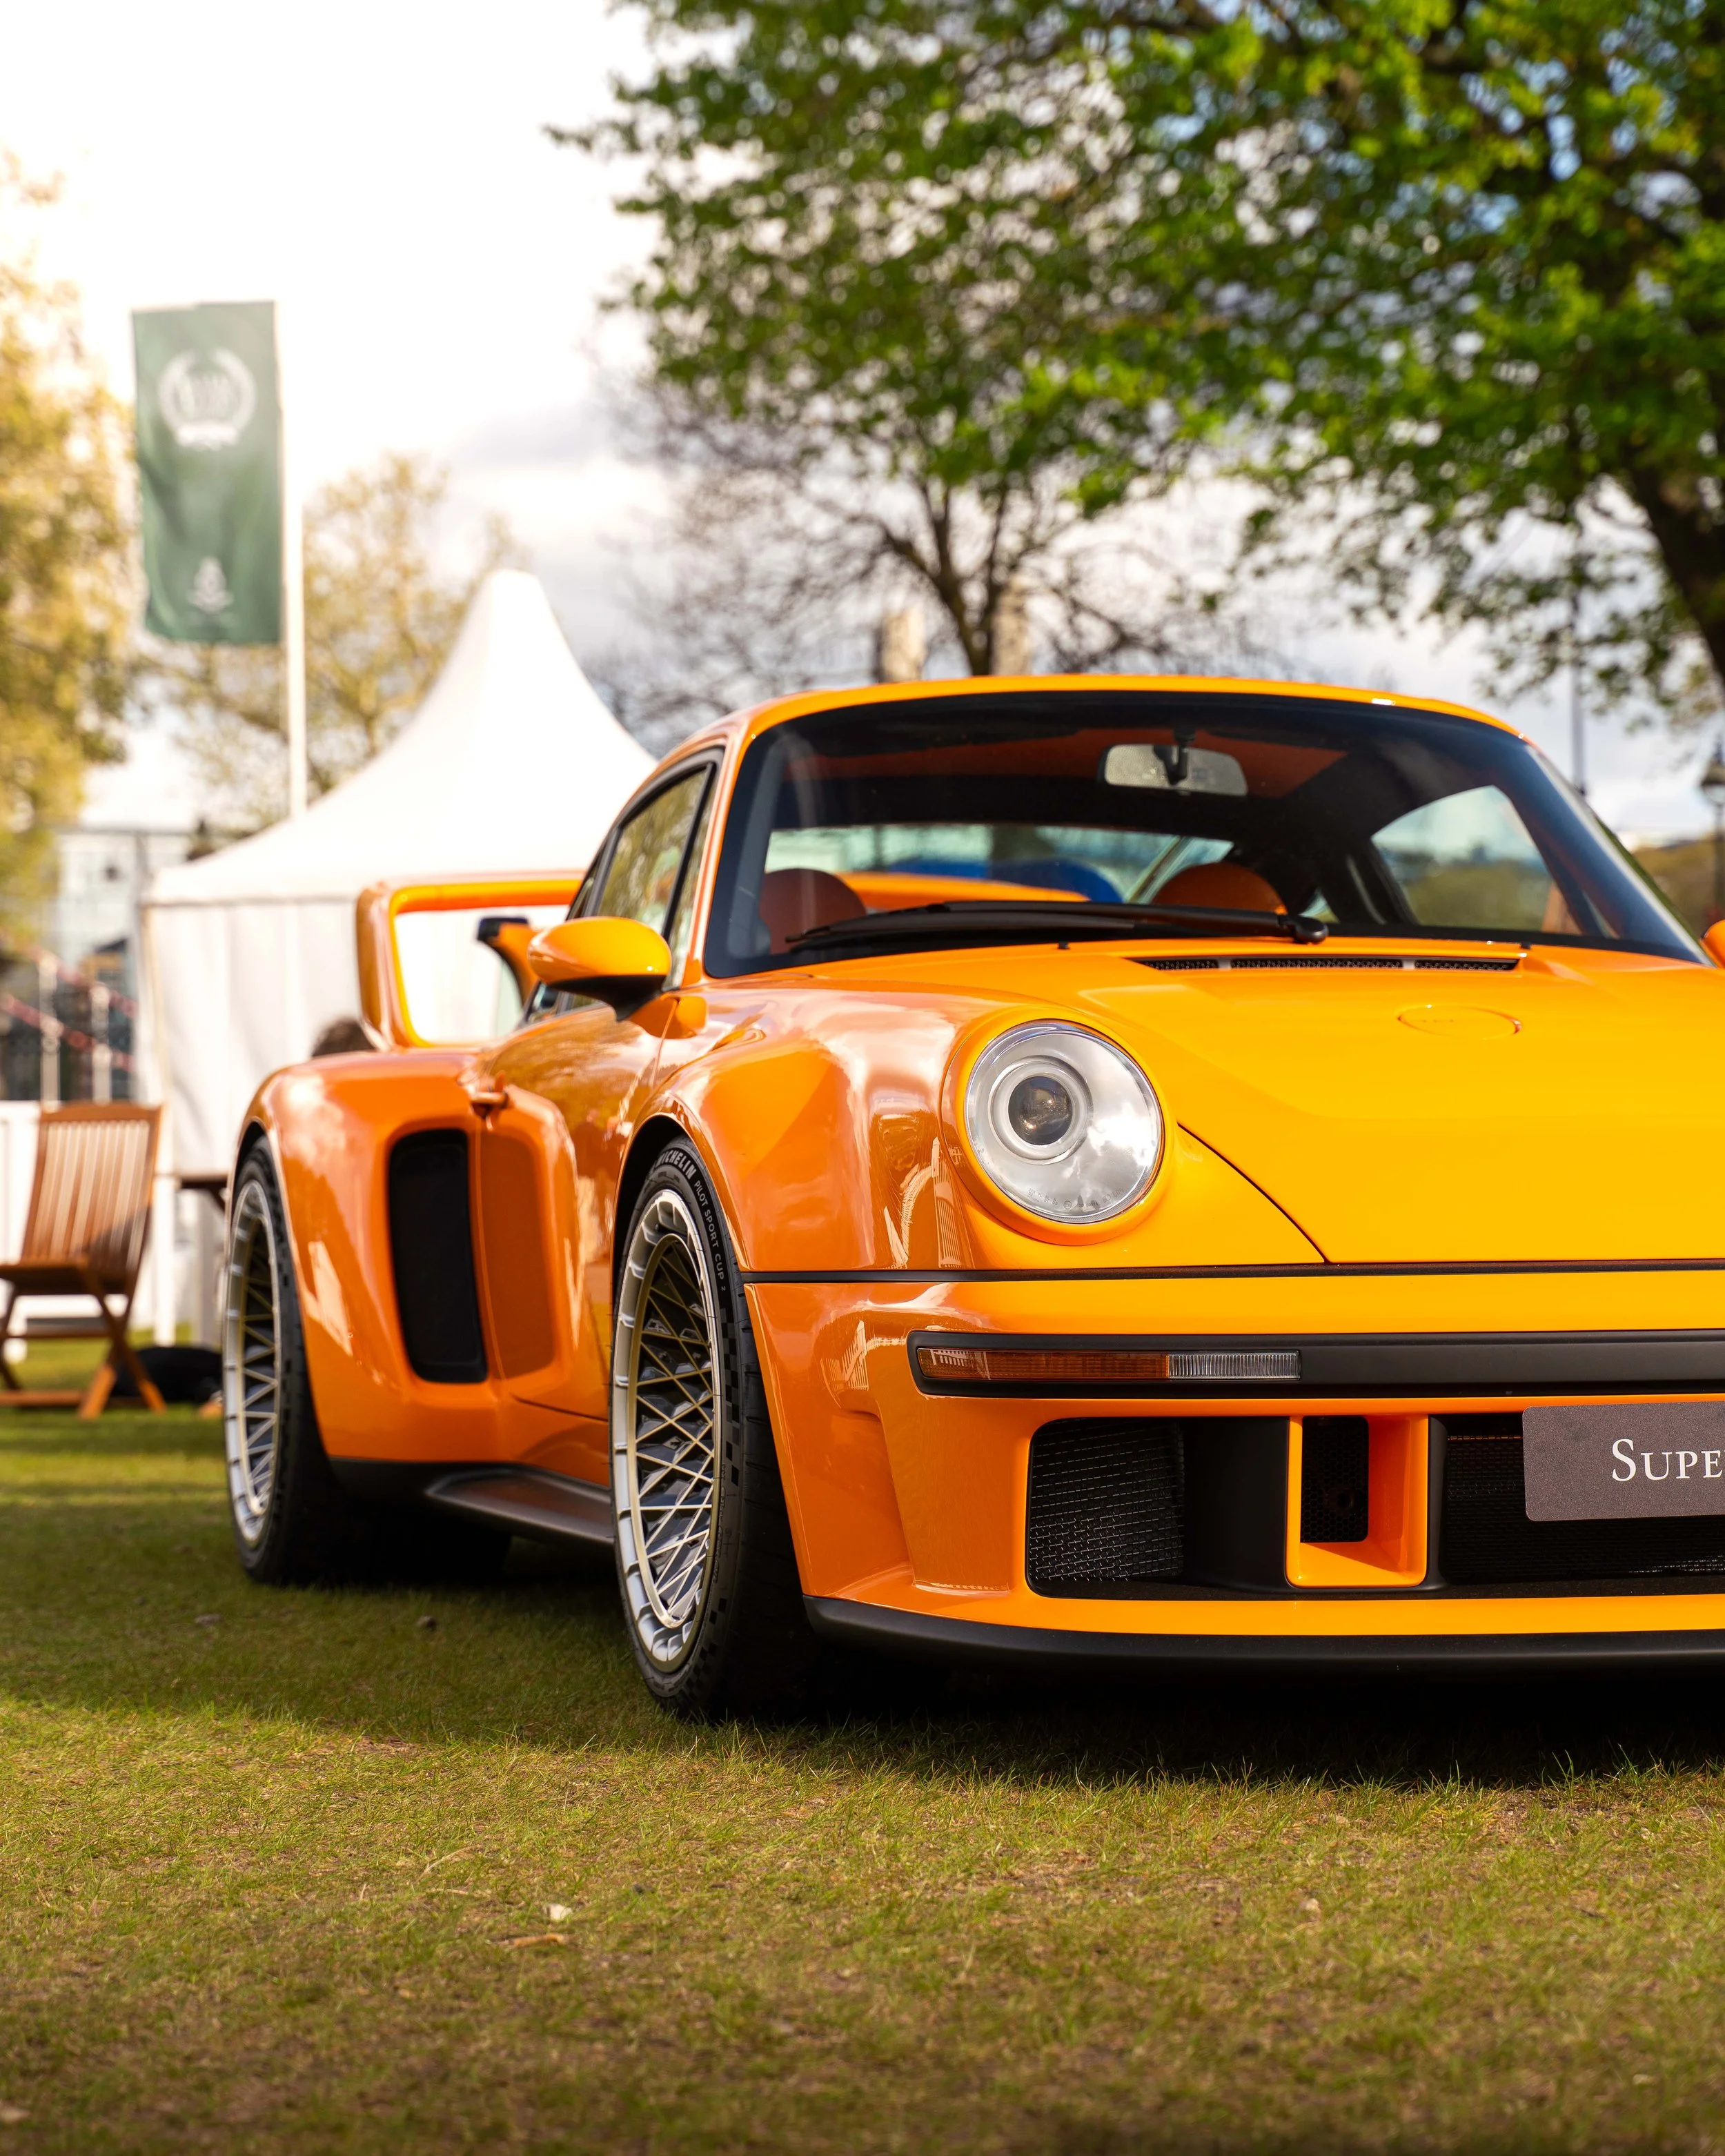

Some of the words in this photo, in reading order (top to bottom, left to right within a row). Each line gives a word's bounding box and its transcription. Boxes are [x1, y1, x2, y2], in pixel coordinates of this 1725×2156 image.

[656, 1149, 697, 1180] MICHELIN
[694, 1180, 708, 1207] PILOT
[704, 1209, 719, 1247] SPORT
[715, 1253, 724, 1280] CUP
[1612, 1438, 1725, 1482] SUPE
